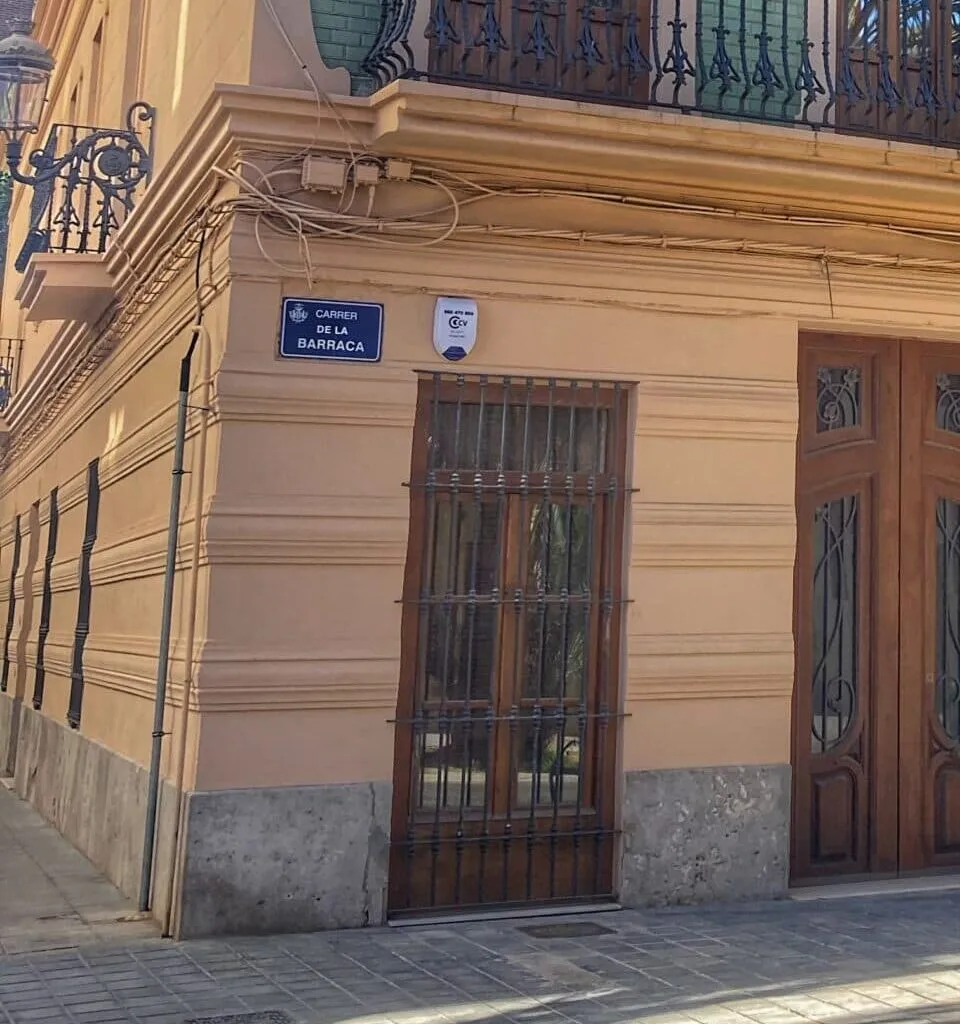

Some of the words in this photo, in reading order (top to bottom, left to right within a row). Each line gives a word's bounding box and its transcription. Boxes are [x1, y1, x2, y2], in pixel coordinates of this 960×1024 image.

[315, 309, 358, 321] CARRER
[316, 324, 331, 335] DE
[334, 325, 348, 336] LA
[297, 337, 365, 353] BARRACA
